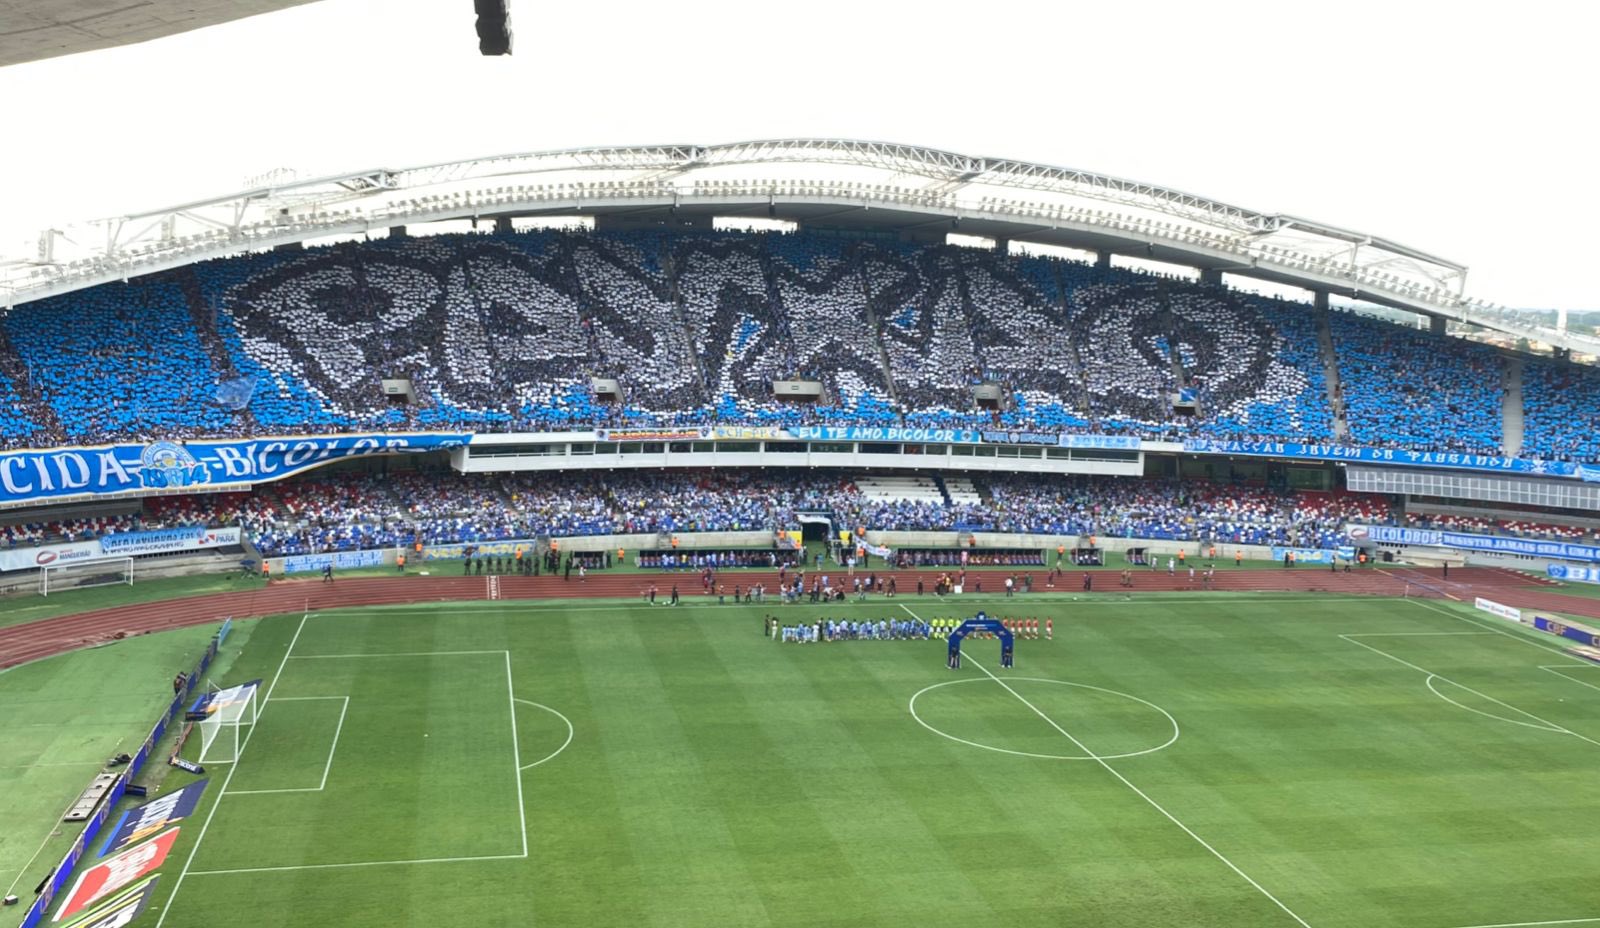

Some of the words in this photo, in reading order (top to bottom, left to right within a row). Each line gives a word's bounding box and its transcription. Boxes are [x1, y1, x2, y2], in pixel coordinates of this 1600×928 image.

[799, 427, 821, 439] EU
[826, 427, 848, 439] TE
[1296, 444, 1361, 458] JOVEM
[1404, 451, 1513, 469] PAYSANDU
[139, 462, 209, 488] 1914
[1494, 539, 1536, 552] JAMAIS
